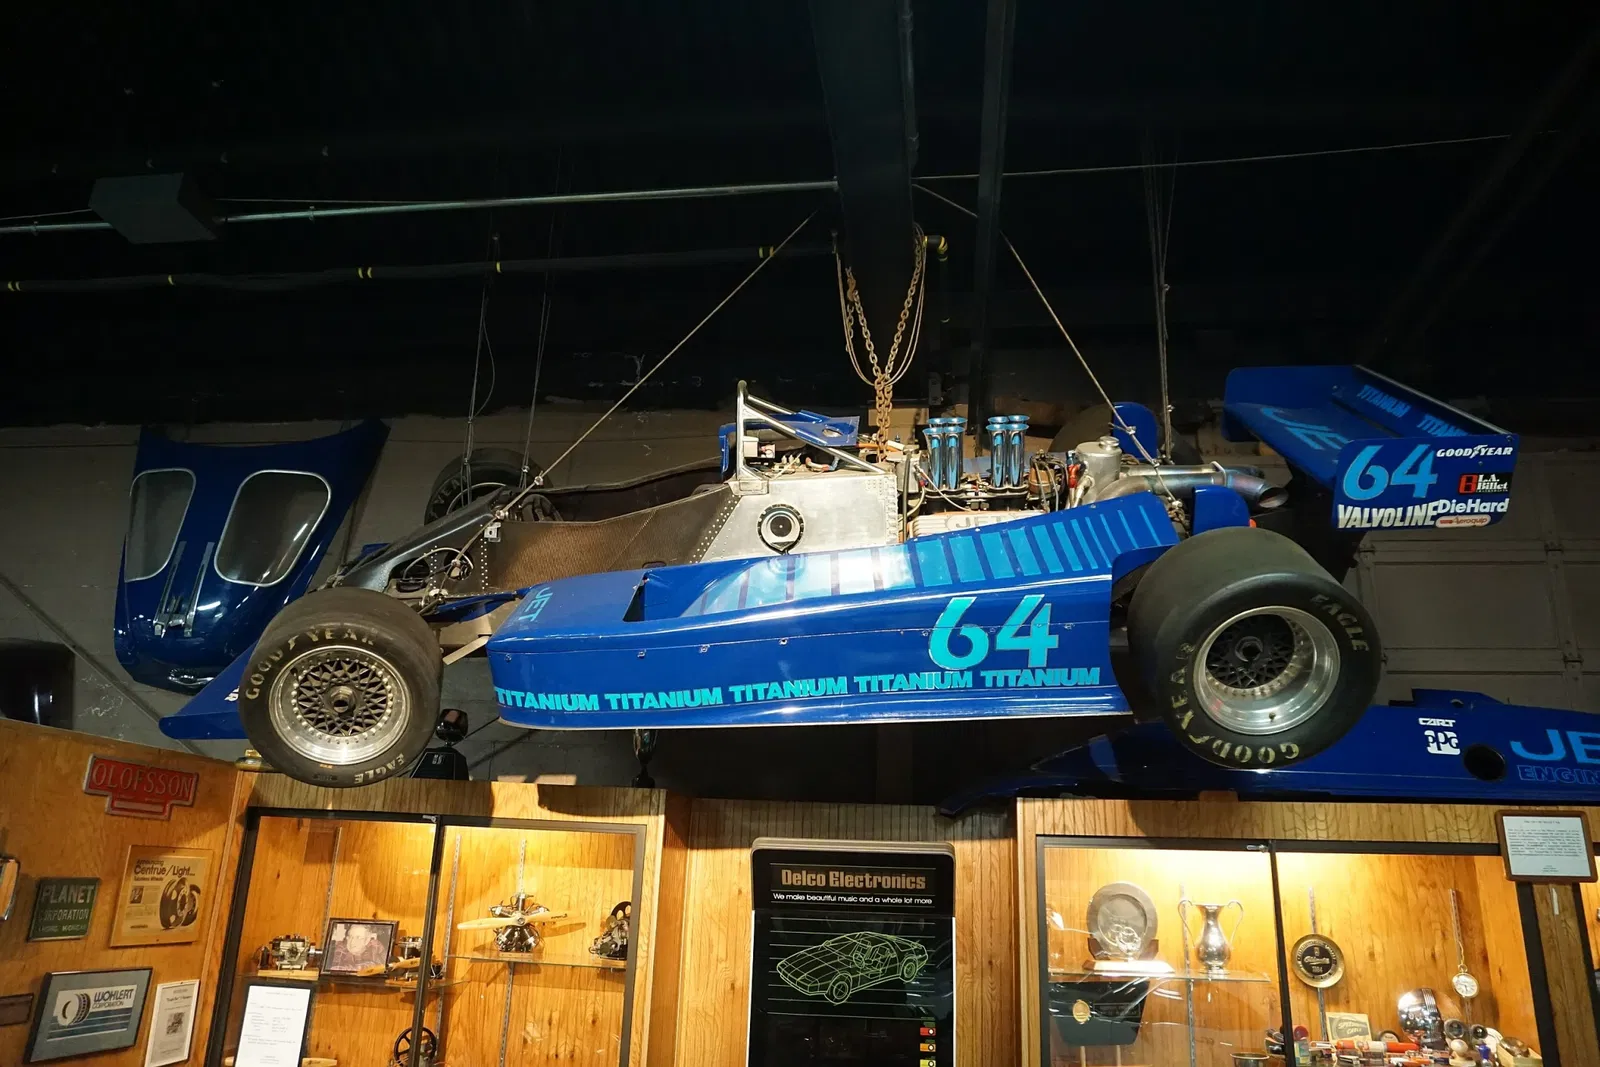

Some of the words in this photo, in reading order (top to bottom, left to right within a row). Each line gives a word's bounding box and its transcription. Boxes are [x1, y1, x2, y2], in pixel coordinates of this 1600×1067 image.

[1343, 444, 1438, 501] 64
[1476, 482, 1509, 490] Billet
[1337, 501, 1439, 529] VALVOLINE
[1437, 498, 1510, 513] DieHard
[928, 594, 1058, 671] 64
[495, 687, 600, 711] TITANIUM
[604, 686, 723, 711] TITANIUM
[728, 675, 848, 702] TITANIUM
[854, 670, 973, 692] TITANIUM
[980, 667, 1100, 687] TITANIUM
[1418, 717, 1456, 727] CART
[92, 763, 194, 799] OLOFSSON
[781, 869, 826, 886] Delco
[829, 871, 926, 889] Electronics
[41, 885, 95, 904] PLANET
[94, 989, 134, 1002] WOHLERT
